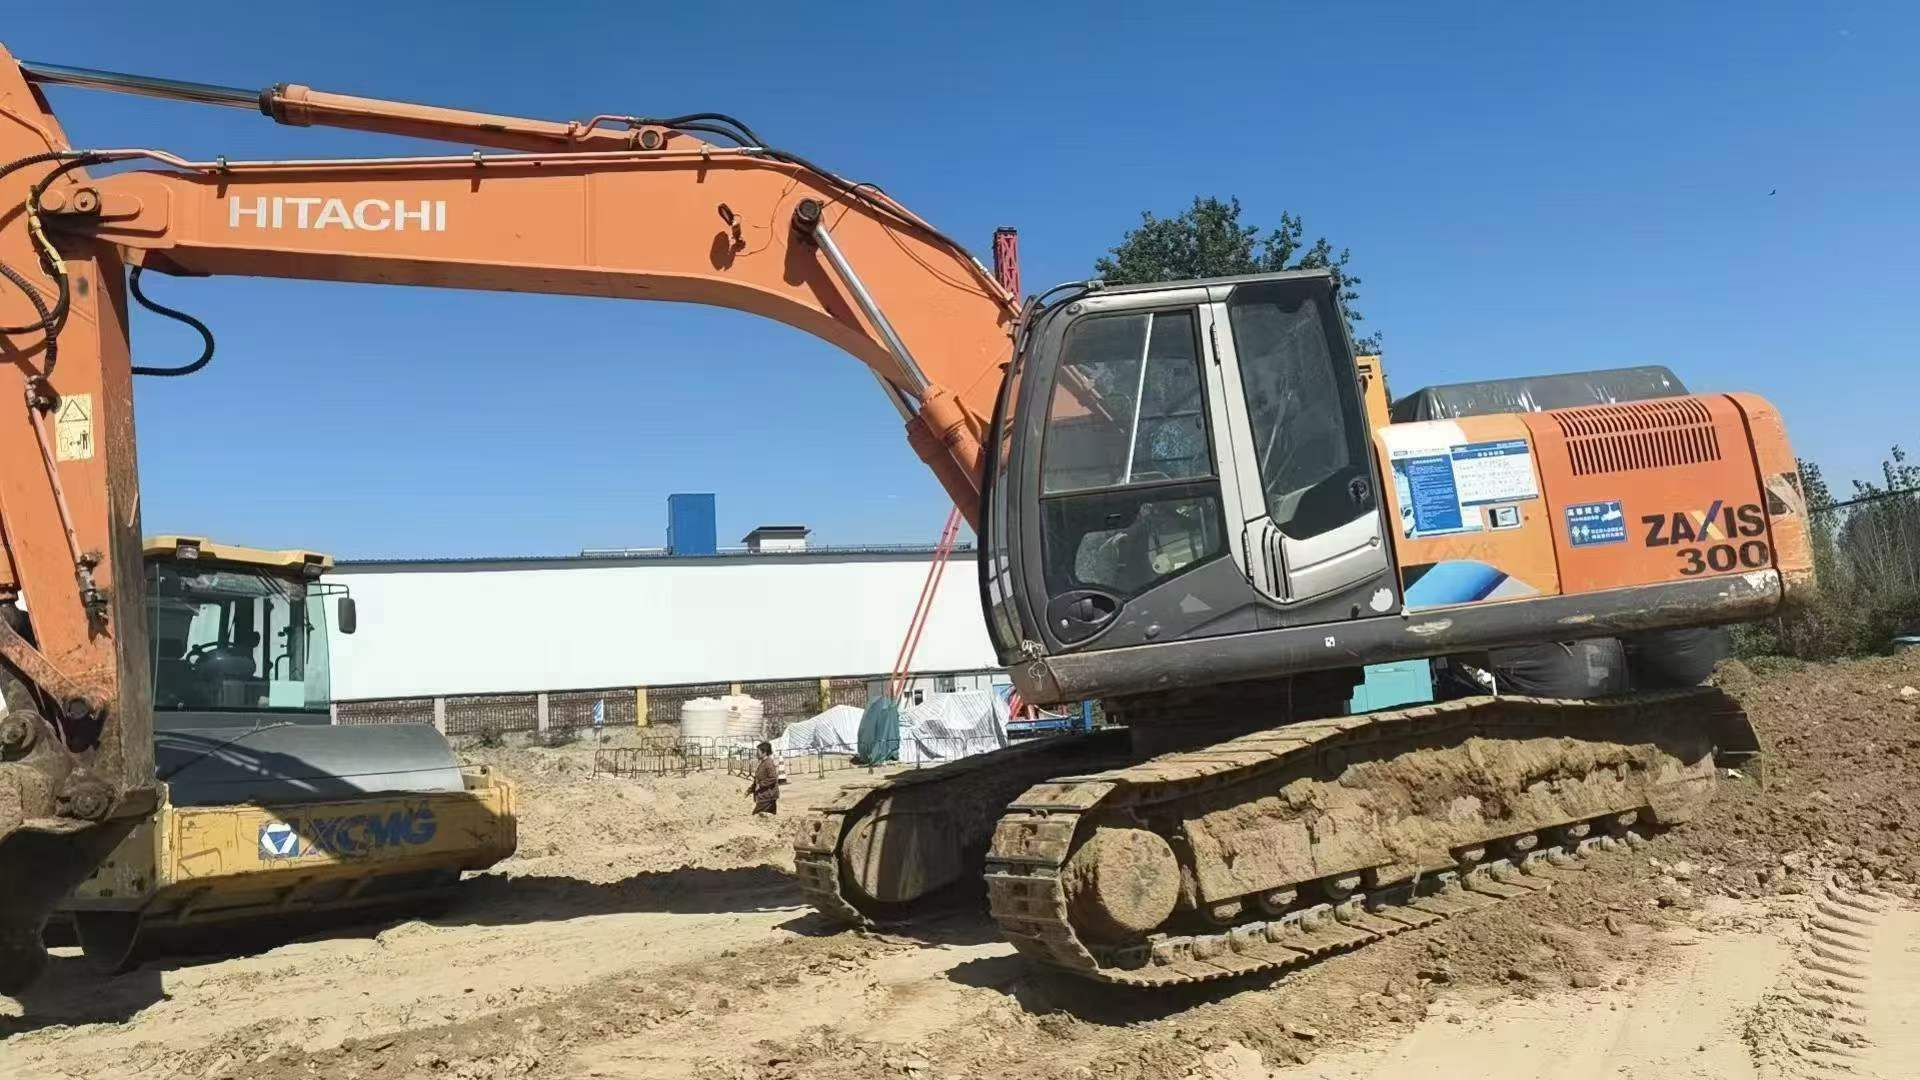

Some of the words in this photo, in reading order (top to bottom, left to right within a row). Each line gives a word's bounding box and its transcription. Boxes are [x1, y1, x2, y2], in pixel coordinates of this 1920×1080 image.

[229, 196, 447, 232] HITACHI
[1641, 500, 1766, 548] ZAXIS
[1676, 540, 1769, 576] 300
[306, 809, 437, 857] XCMG
